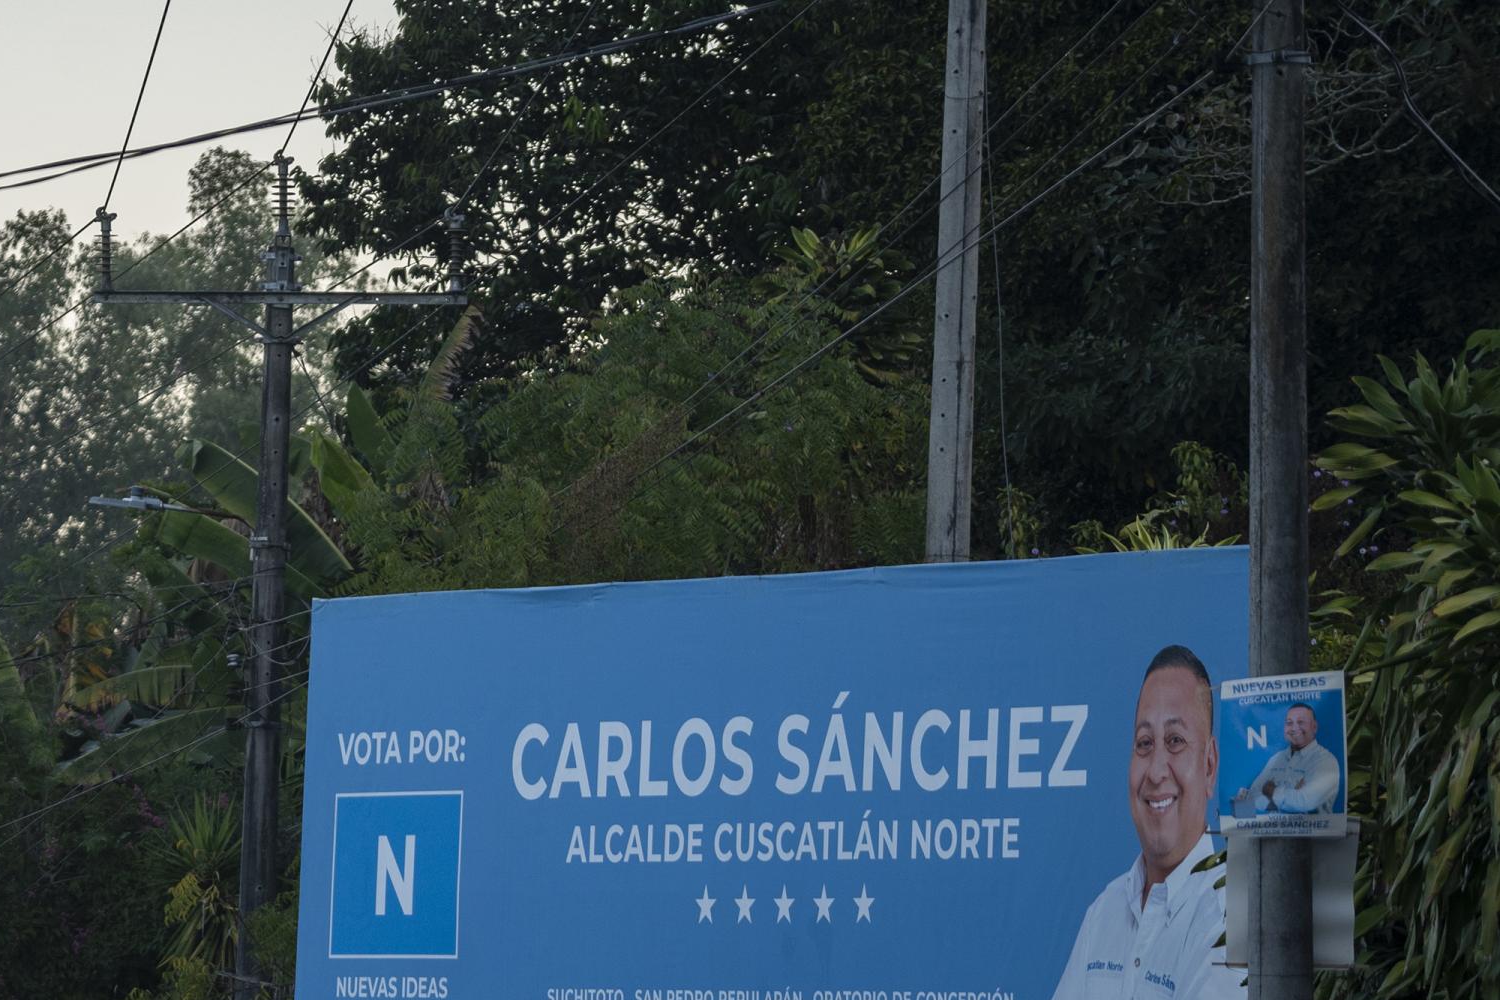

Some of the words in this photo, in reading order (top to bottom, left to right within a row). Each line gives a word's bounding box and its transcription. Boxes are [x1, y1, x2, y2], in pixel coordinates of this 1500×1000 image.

[1232, 680, 1282, 694] NUEVAS
[1285, 676, 1326, 689] IDEAS
[1290, 691, 1321, 702] NORTE
[338, 731, 402, 766] VOTA
[408, 729, 466, 764] POR:
[511, 715, 754, 801] CARLOS
[775, 690, 1089, 795] SÁNCHEZ
[1247, 725, 1268, 749] N
[565, 823, 704, 864] ALCALDE
[713, 811, 899, 863] CUSCATLÁN
[910, 817, 1020, 860] NORTE
[1236, 821, 1278, 830] CARLOS
[375, 834, 416, 916] N
[335, 976, 398, 999] NUEVAS
[401, 976, 448, 999] IDEAS
